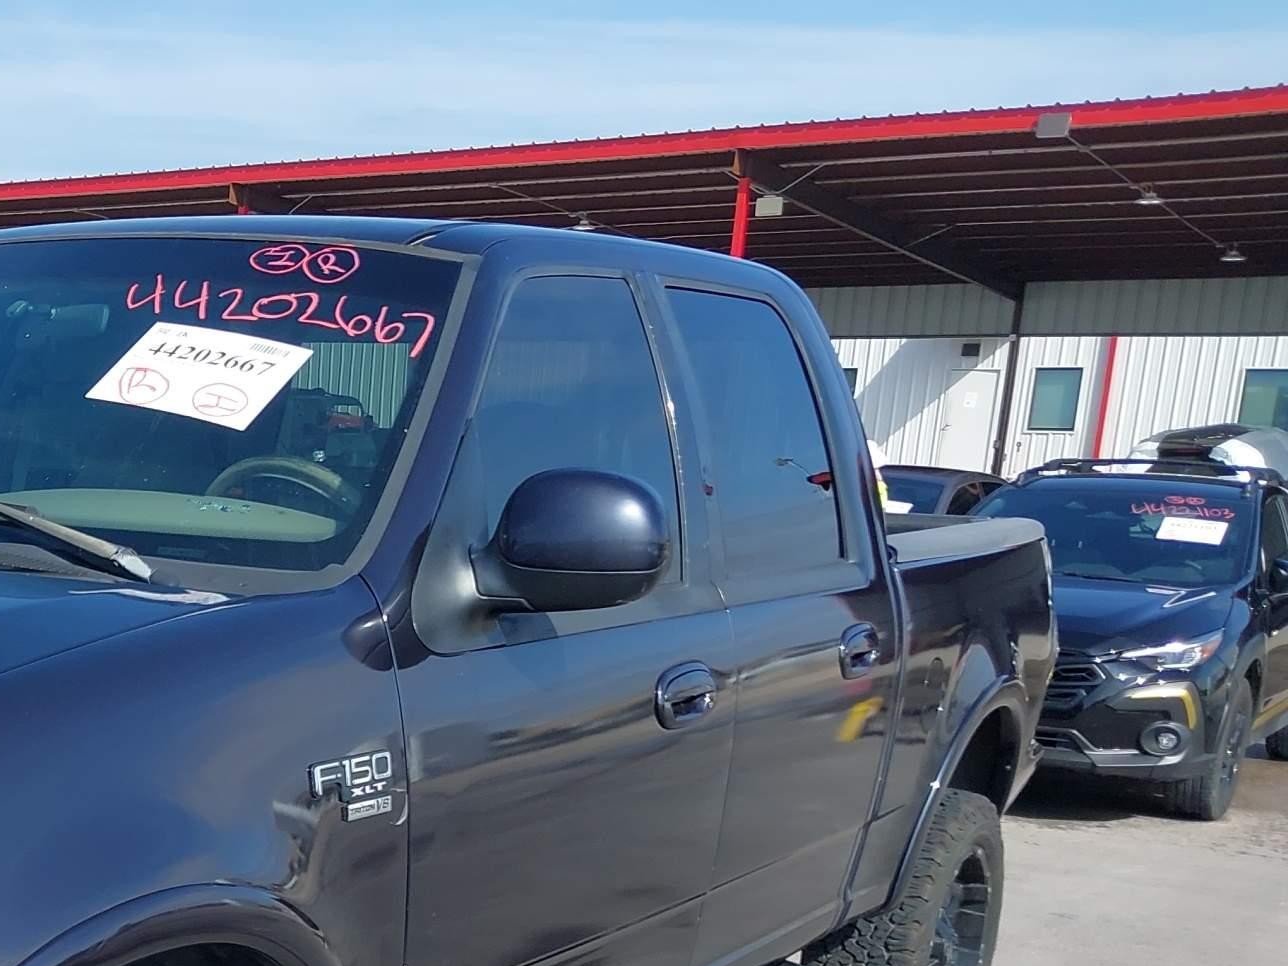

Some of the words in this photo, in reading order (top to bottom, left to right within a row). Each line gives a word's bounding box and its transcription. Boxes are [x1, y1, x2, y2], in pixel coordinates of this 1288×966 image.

[126, 274, 435, 358] 44202667
[148, 342, 277, 376] 44202667
[313, 751, 392, 796] F-150
[350, 781, 387, 798] XLT
[376, 797, 391, 812] V8
